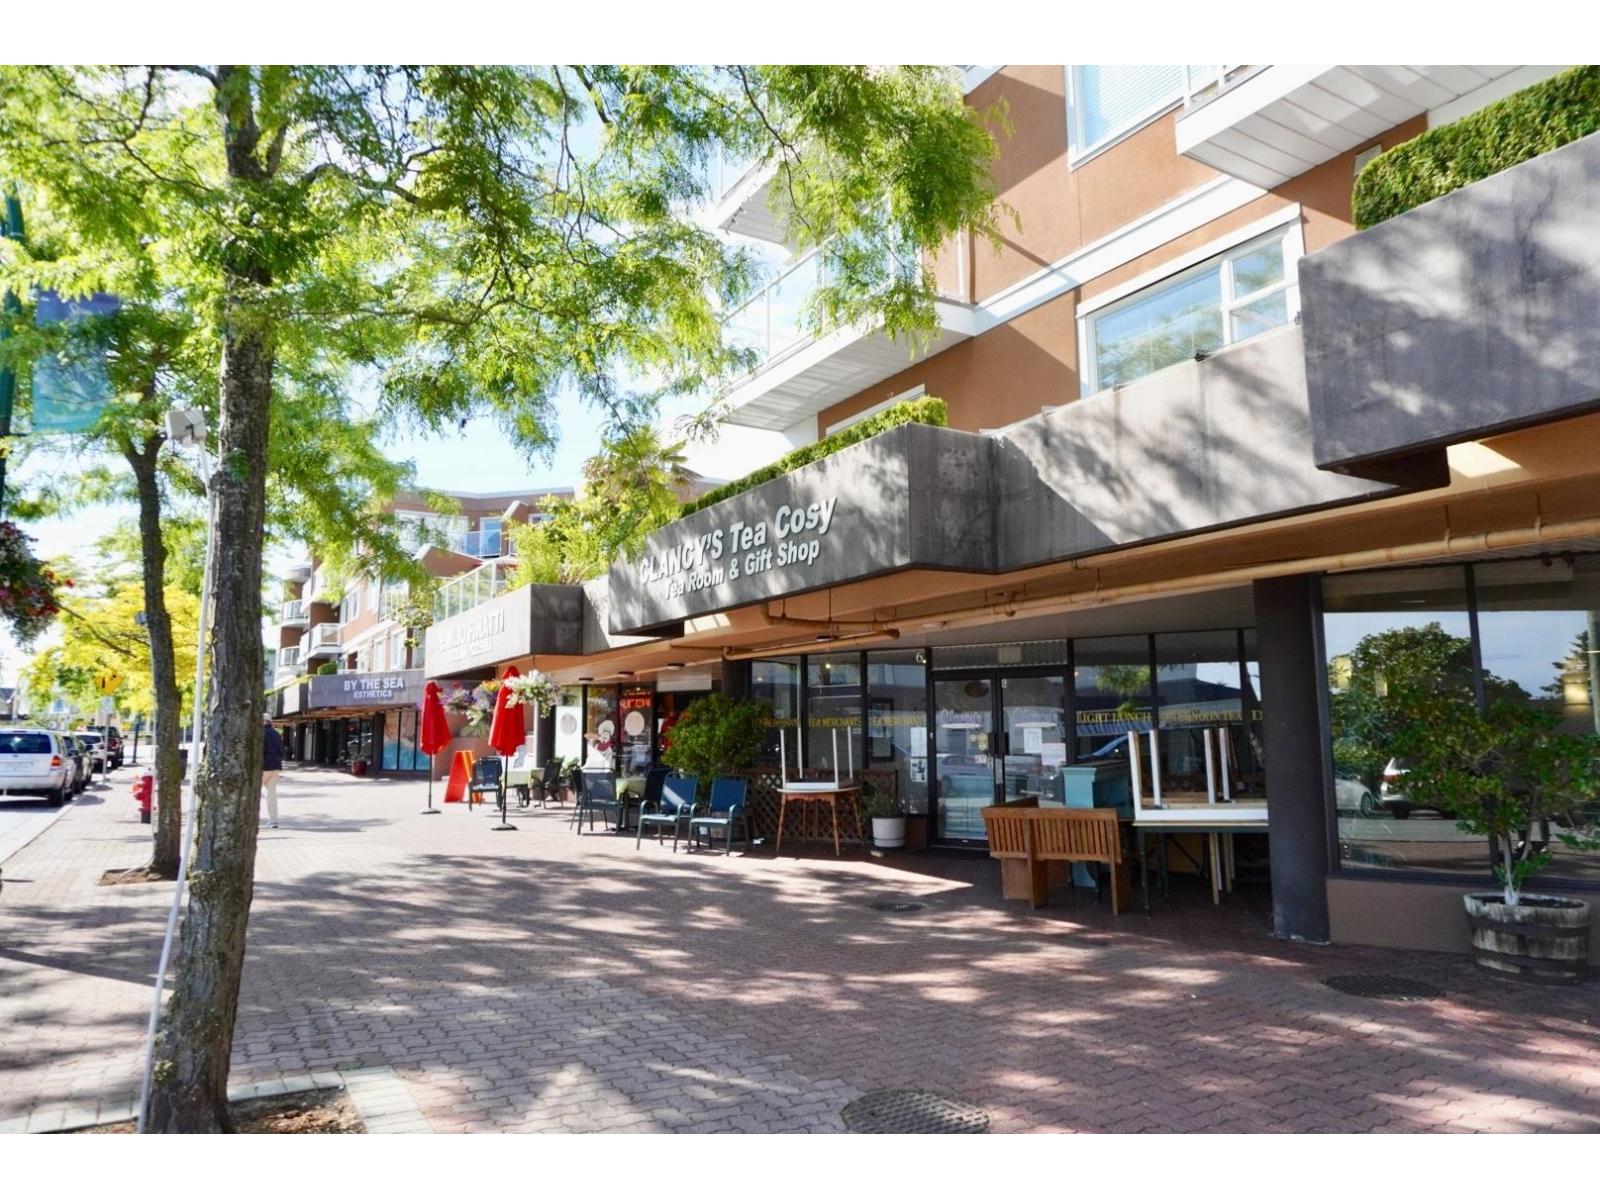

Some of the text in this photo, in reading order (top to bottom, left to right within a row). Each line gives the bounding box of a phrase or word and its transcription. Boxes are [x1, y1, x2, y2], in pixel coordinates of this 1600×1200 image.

[640, 497, 838, 585] CLANCY'S Tea Cosy
[665, 539, 820, 599] Tea Room & Gift Shop
[343, 677, 404, 691] BY THE SEA
[353, 689, 393, 699] ESTHETICS
[1076, 711, 1109, 723] LIGHT
